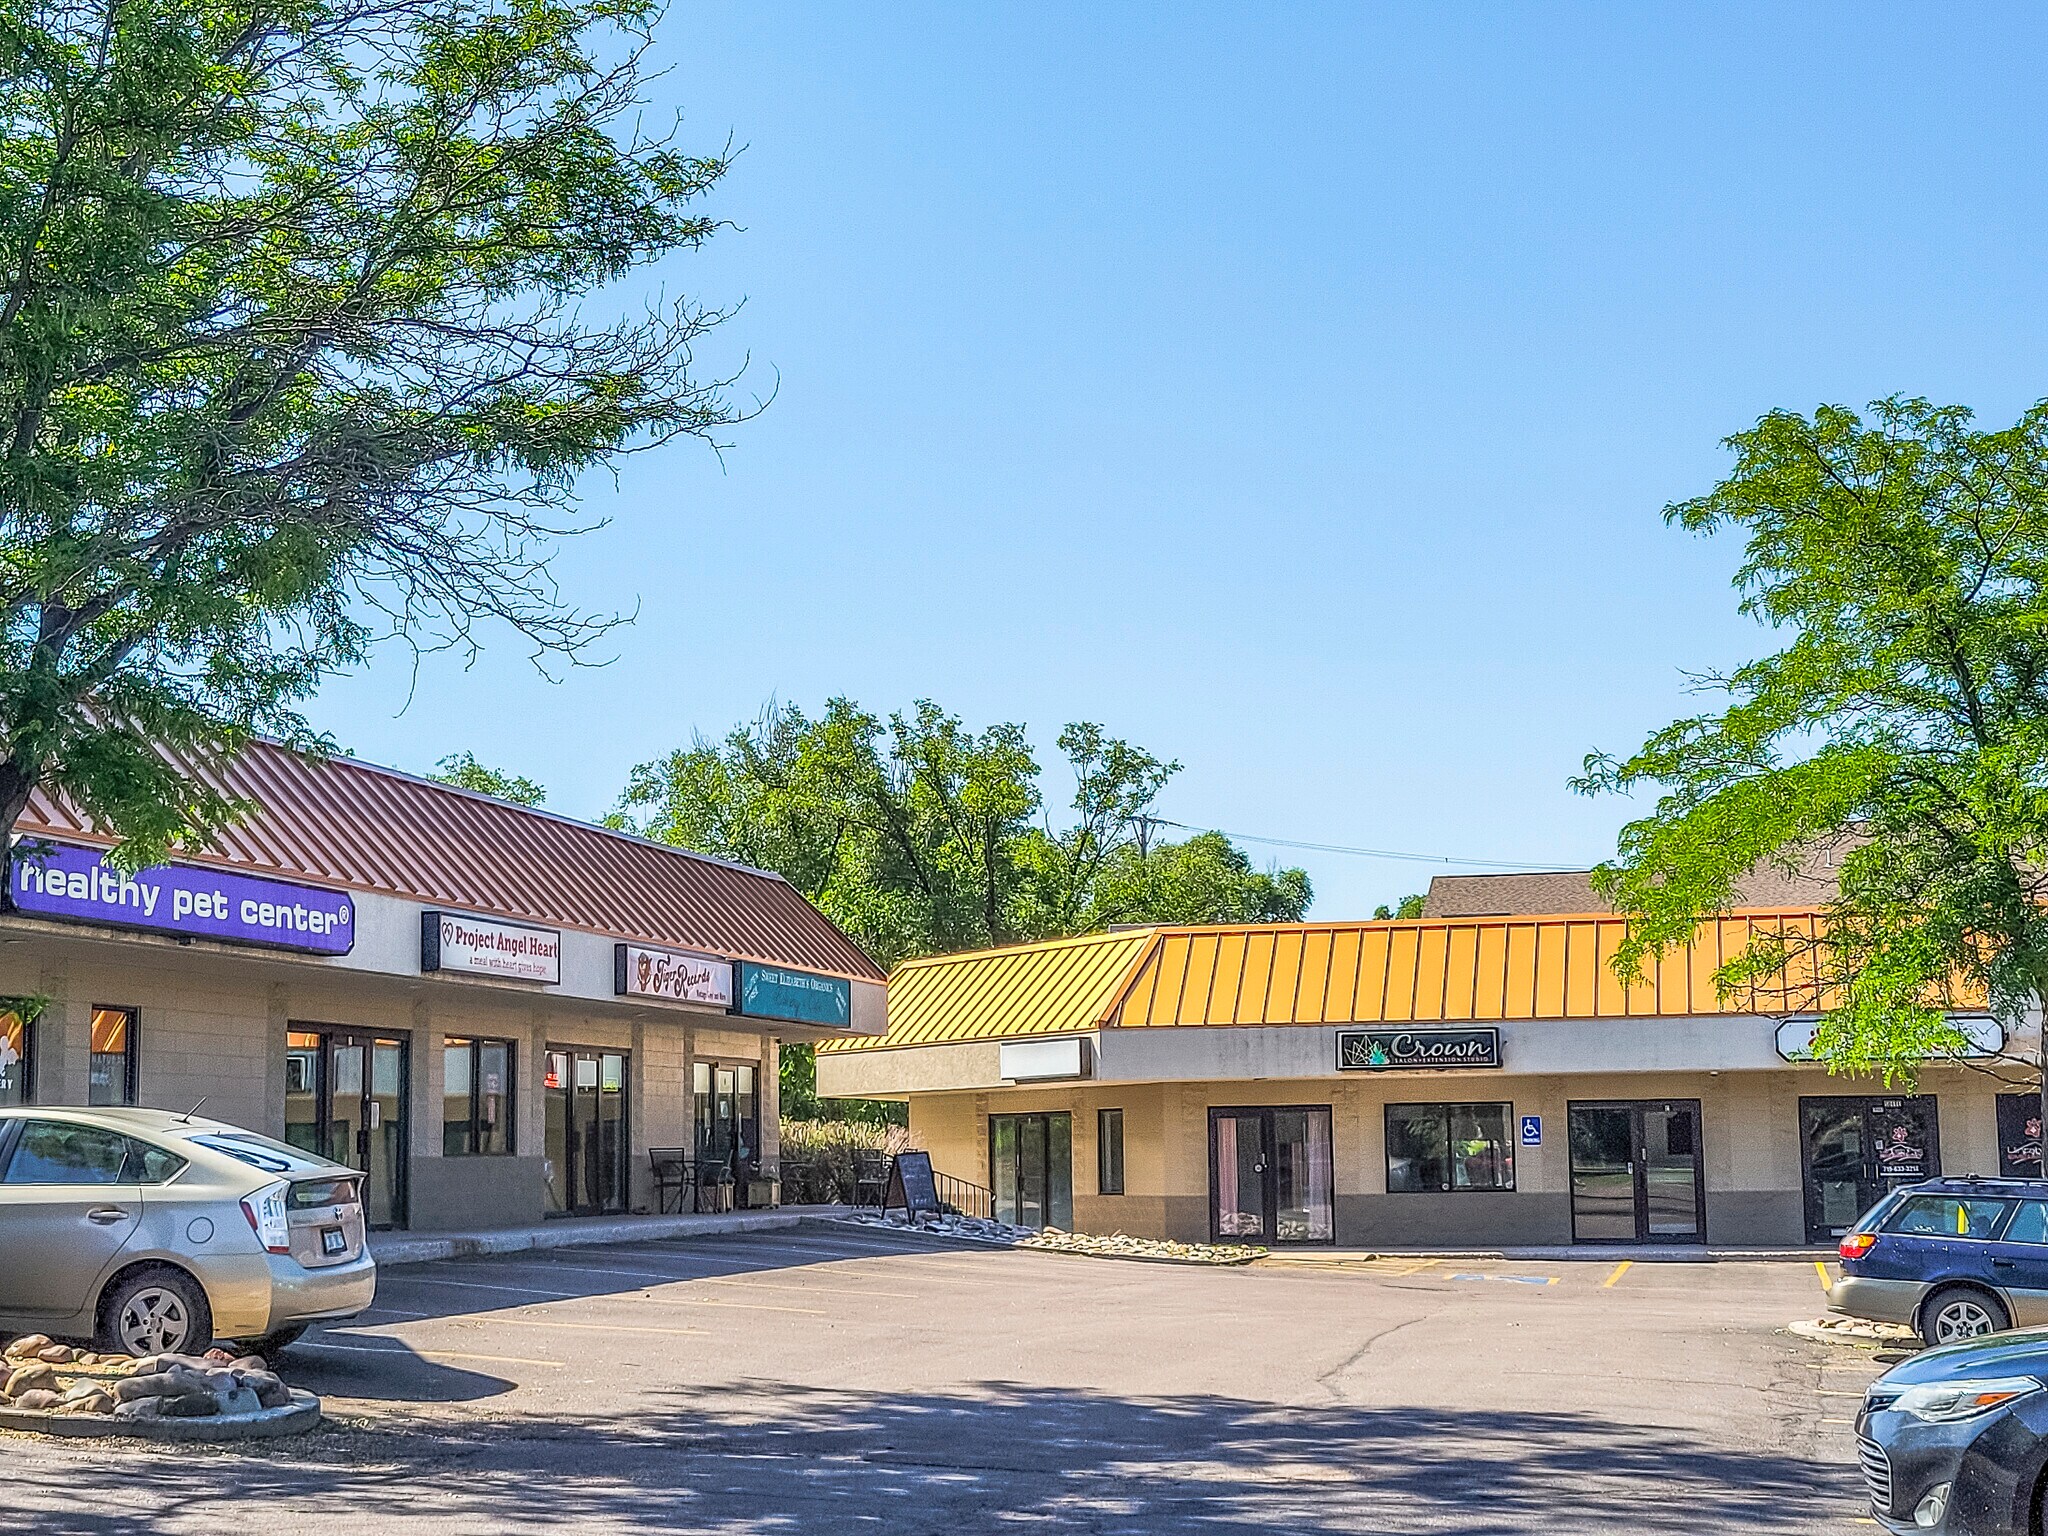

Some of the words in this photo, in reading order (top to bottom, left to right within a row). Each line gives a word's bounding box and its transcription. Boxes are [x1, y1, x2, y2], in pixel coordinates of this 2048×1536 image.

[20, 861, 160, 917] healthy
[173, 889, 228, 921] pet
[455, 926, 495, 952] Project
[497, 932, 527, 957] Angel
[530, 937, 557, 958] Heart
[653, 954, 677, 993] Tiger
[674, 964, 710, 998] Records
[1391, 1034, 1490, 1058] Crown
